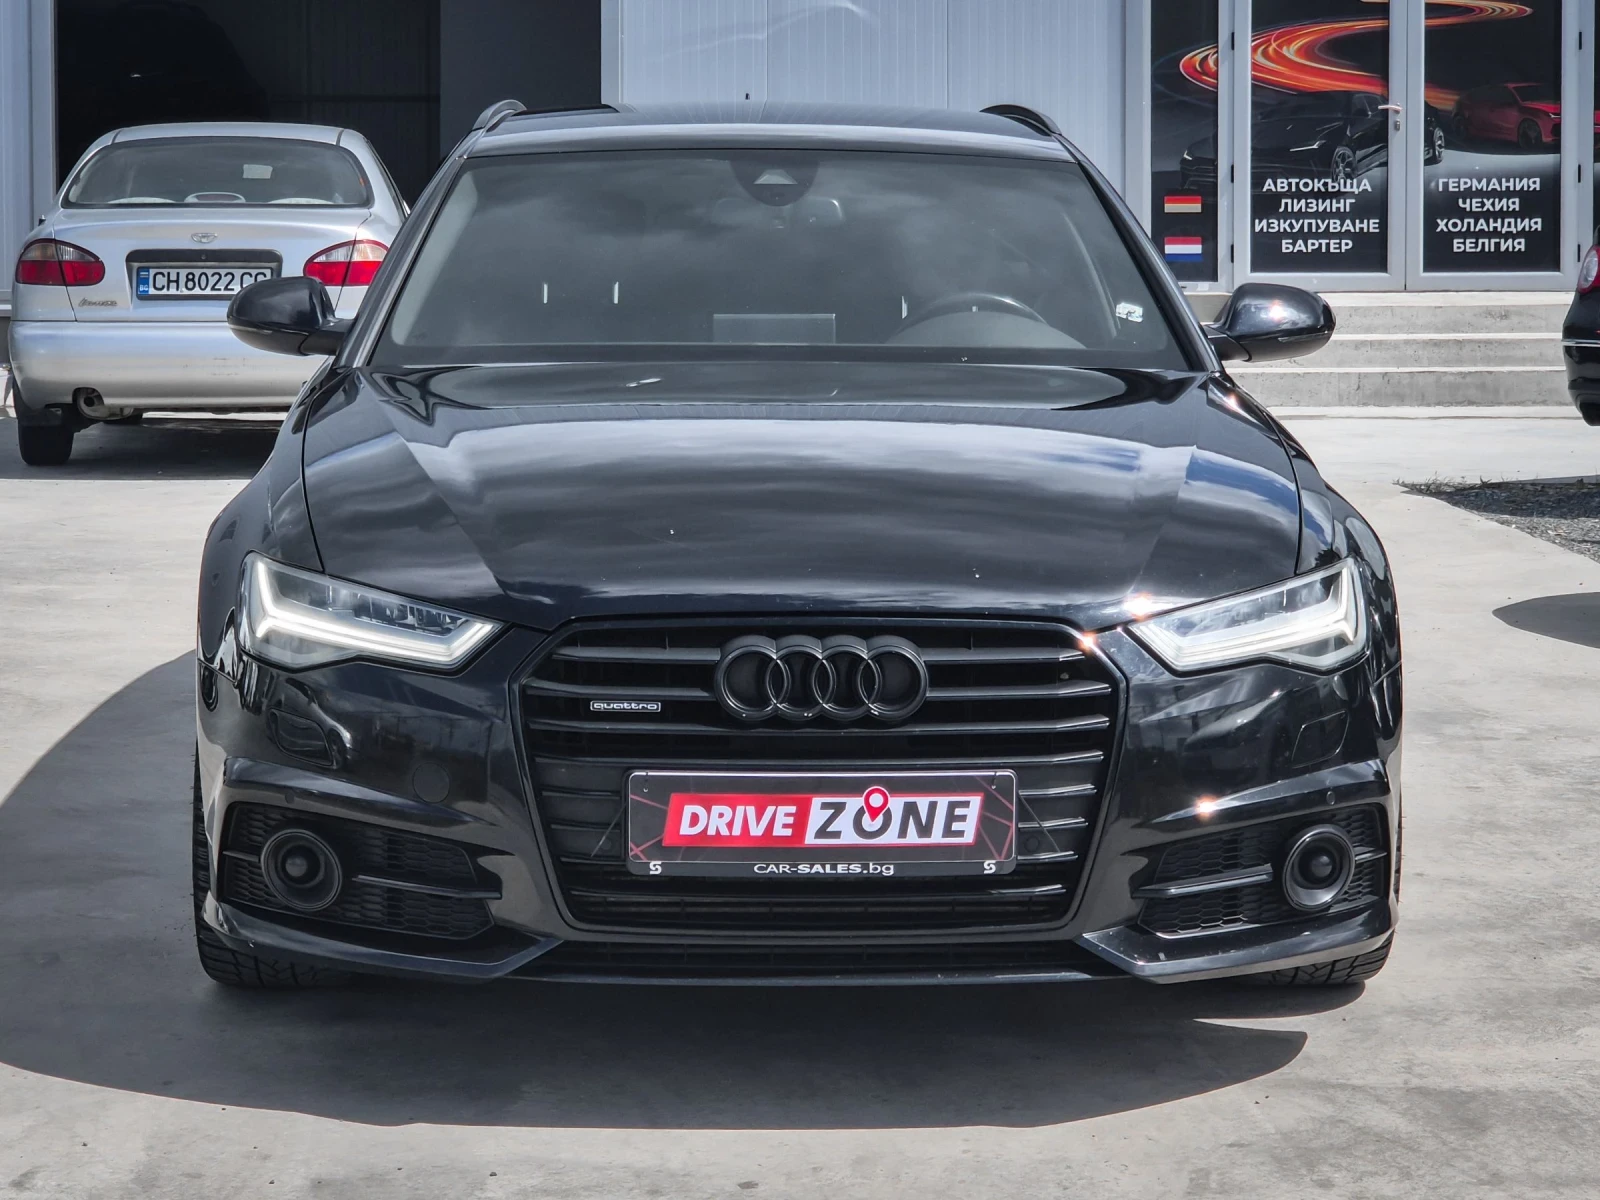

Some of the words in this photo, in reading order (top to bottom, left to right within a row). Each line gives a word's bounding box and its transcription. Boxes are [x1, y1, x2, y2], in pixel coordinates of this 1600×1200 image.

[1262, 178, 1372, 194] АВТОКЪЩА
[1438, 177, 1541, 192] ГЕРМАНИЯ
[1278, 198, 1356, 213] ЛИЗИНГ
[1458, 197, 1520, 212] ЧЕХИЯ
[1254, 218, 1380, 233] ИЗКУПУВАНЕ
[1435, 217, 1542, 234] ХОЛАНДИЯ
[1281, 239, 1353, 253] БАРТЕР
[1452, 238, 1526, 253] БЕЛГИЯ
[184, 271, 235, 291] 8022
[593, 702, 658, 710] quattro
[679, 804, 797, 837] DRIVE
[813, 799, 971, 840] ZONE
[753, 863, 895, 877] CAR-SALES.bg
